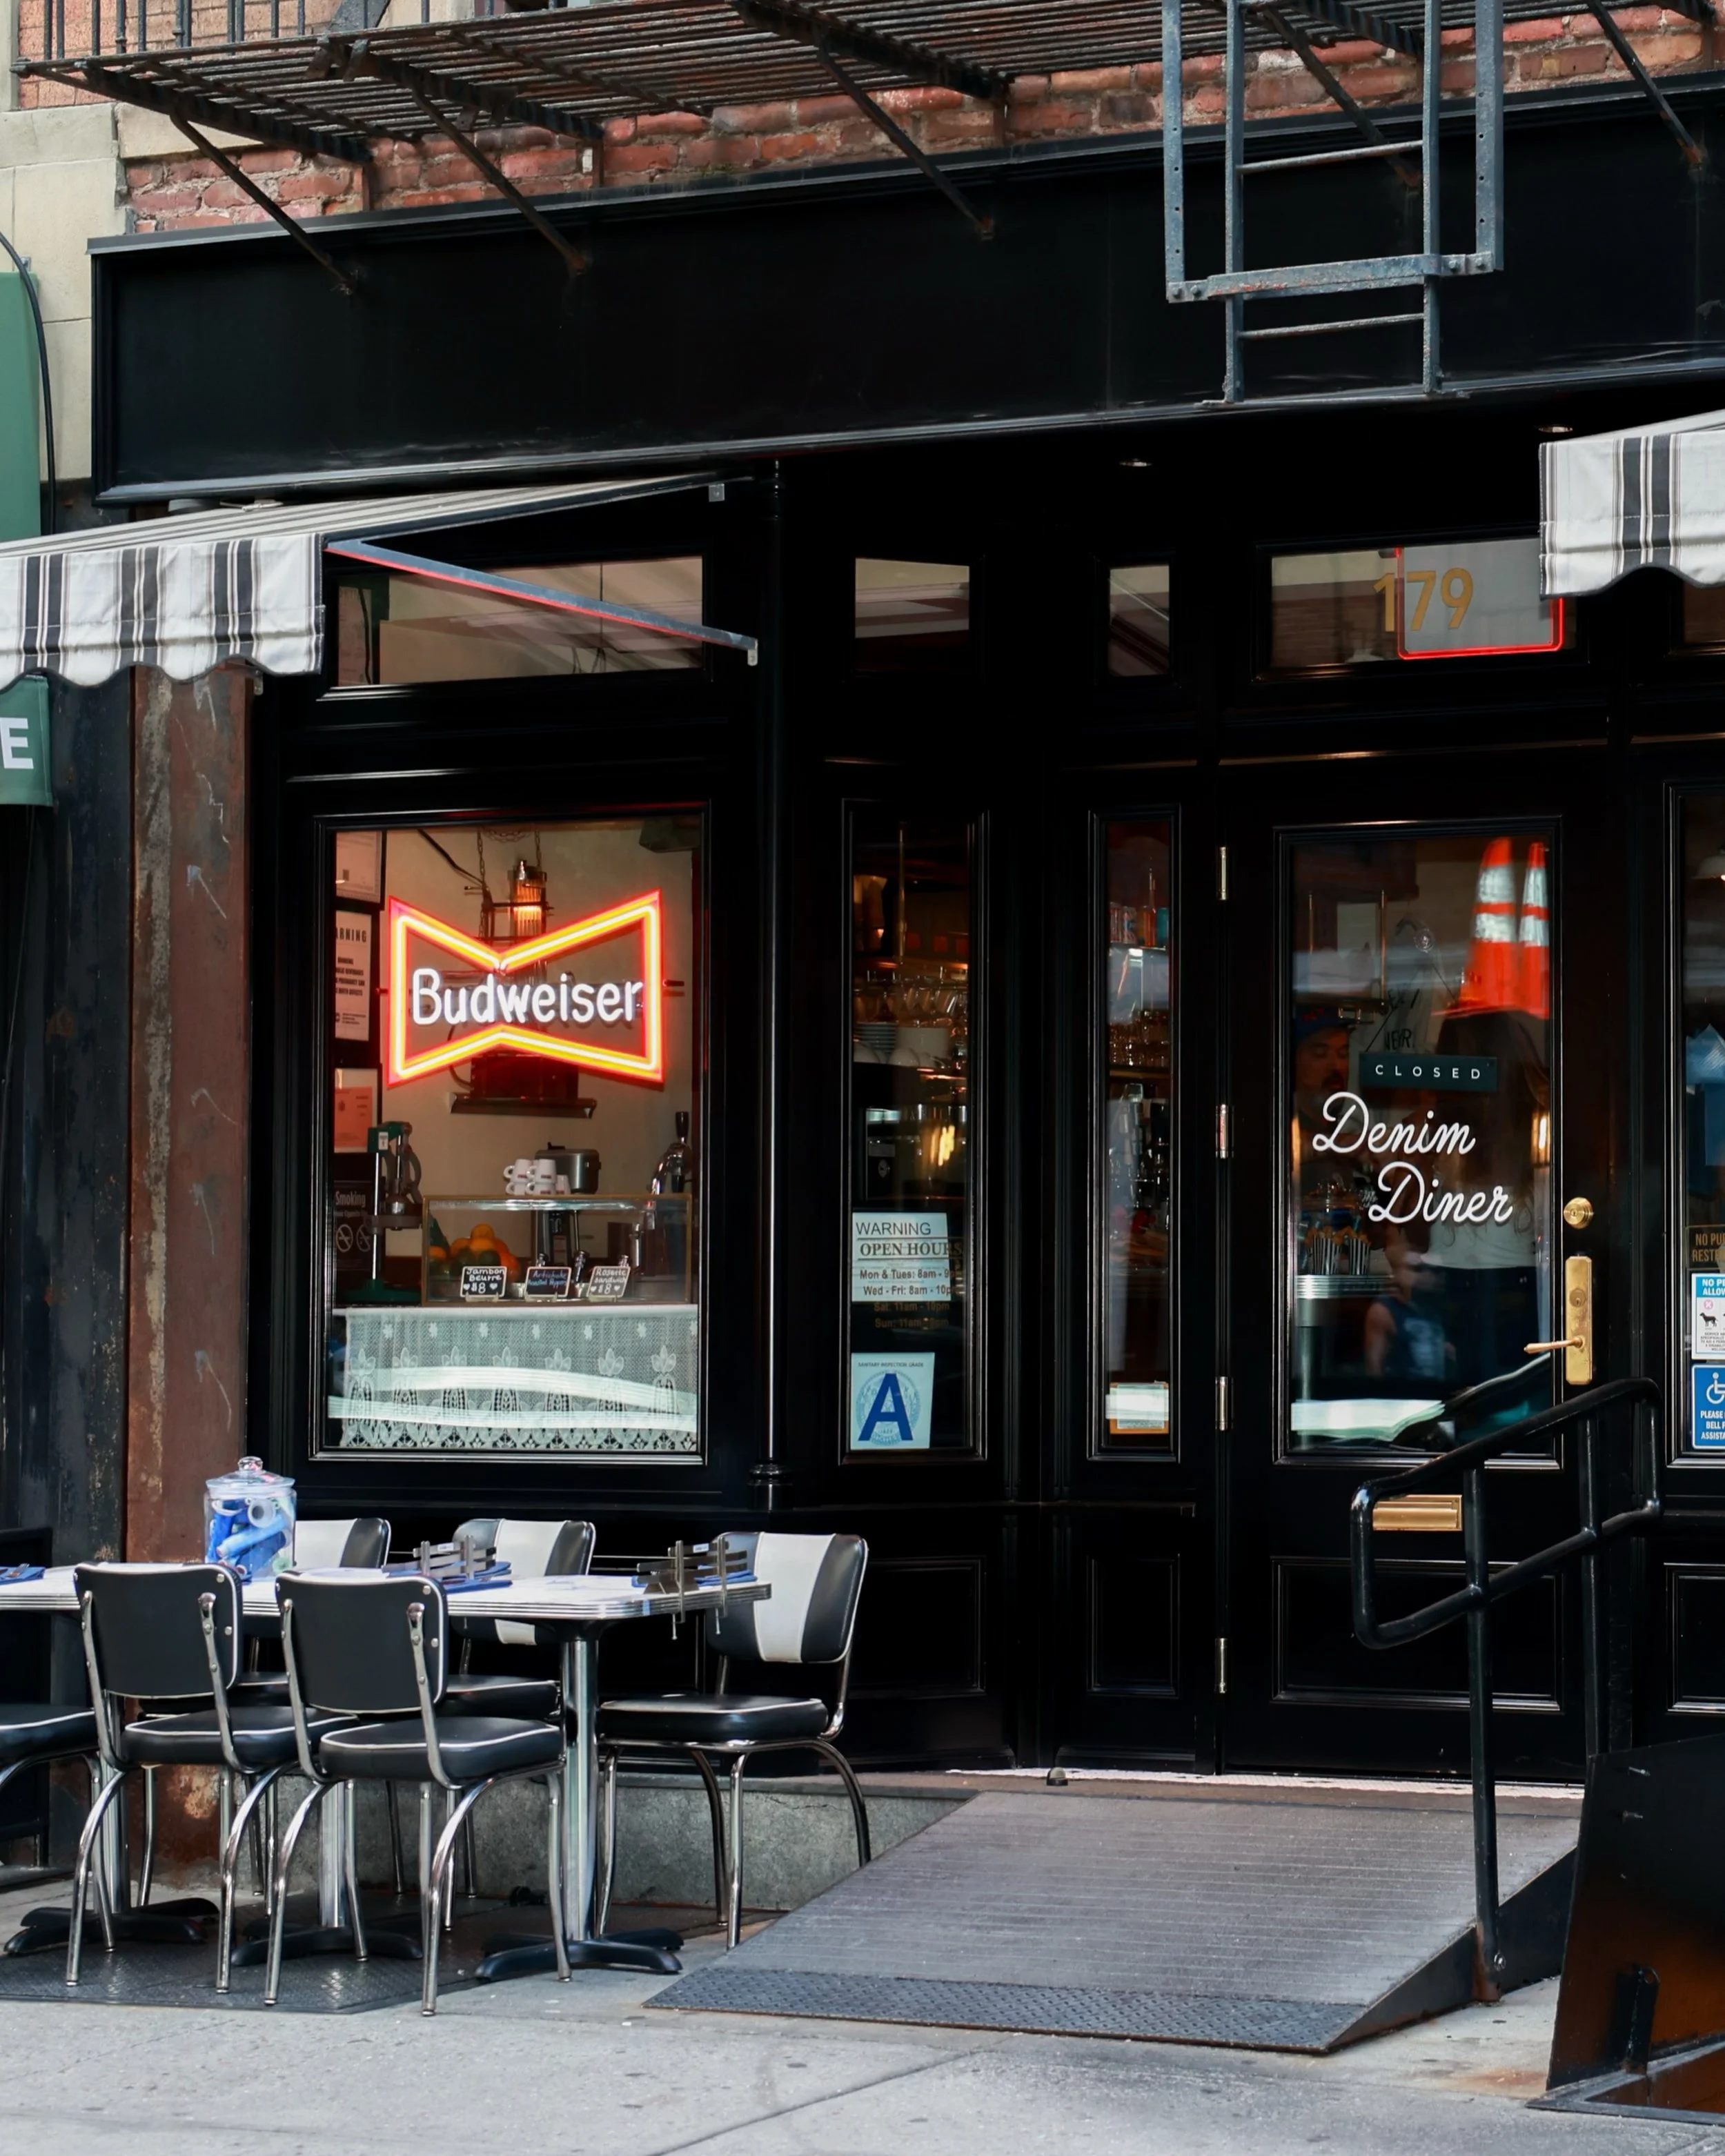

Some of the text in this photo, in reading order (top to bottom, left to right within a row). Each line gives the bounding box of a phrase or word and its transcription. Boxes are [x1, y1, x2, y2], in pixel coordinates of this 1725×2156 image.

[1372, 567, 1474, 632] 179
[0, 718, 34, 769] E
[413, 968, 643, 1025] Budweiser
[1375, 1065, 1481, 1080] CLOSED
[1312, 1091, 1476, 1155] Denim
[335, 1190, 366, 1208] Smoking
[1368, 1161, 1513, 1224] Diner
[856, 1222, 931, 1236] WARNING
[1695, 1233, 1708, 1246] NO
[860, 1243, 903, 1256] OPEN
[860, 1269, 878, 1280] Mon
[882, 1269, 888, 1279] &
[891, 1269, 915, 1279] Tues:
[918, 1269, 936, 1278] 8am
[1702, 1278, 1715, 1287] NO
[863, 1285, 883, 1296] Wed
[891, 1285, 906, 1295] Fri:
[909, 1285, 927, 1294] 8am
[858, 1373, 914, 1441] A
[1700, 1410, 1724, 1419] PLEASE
[1706, 1421, 1721, 1430] BELL
